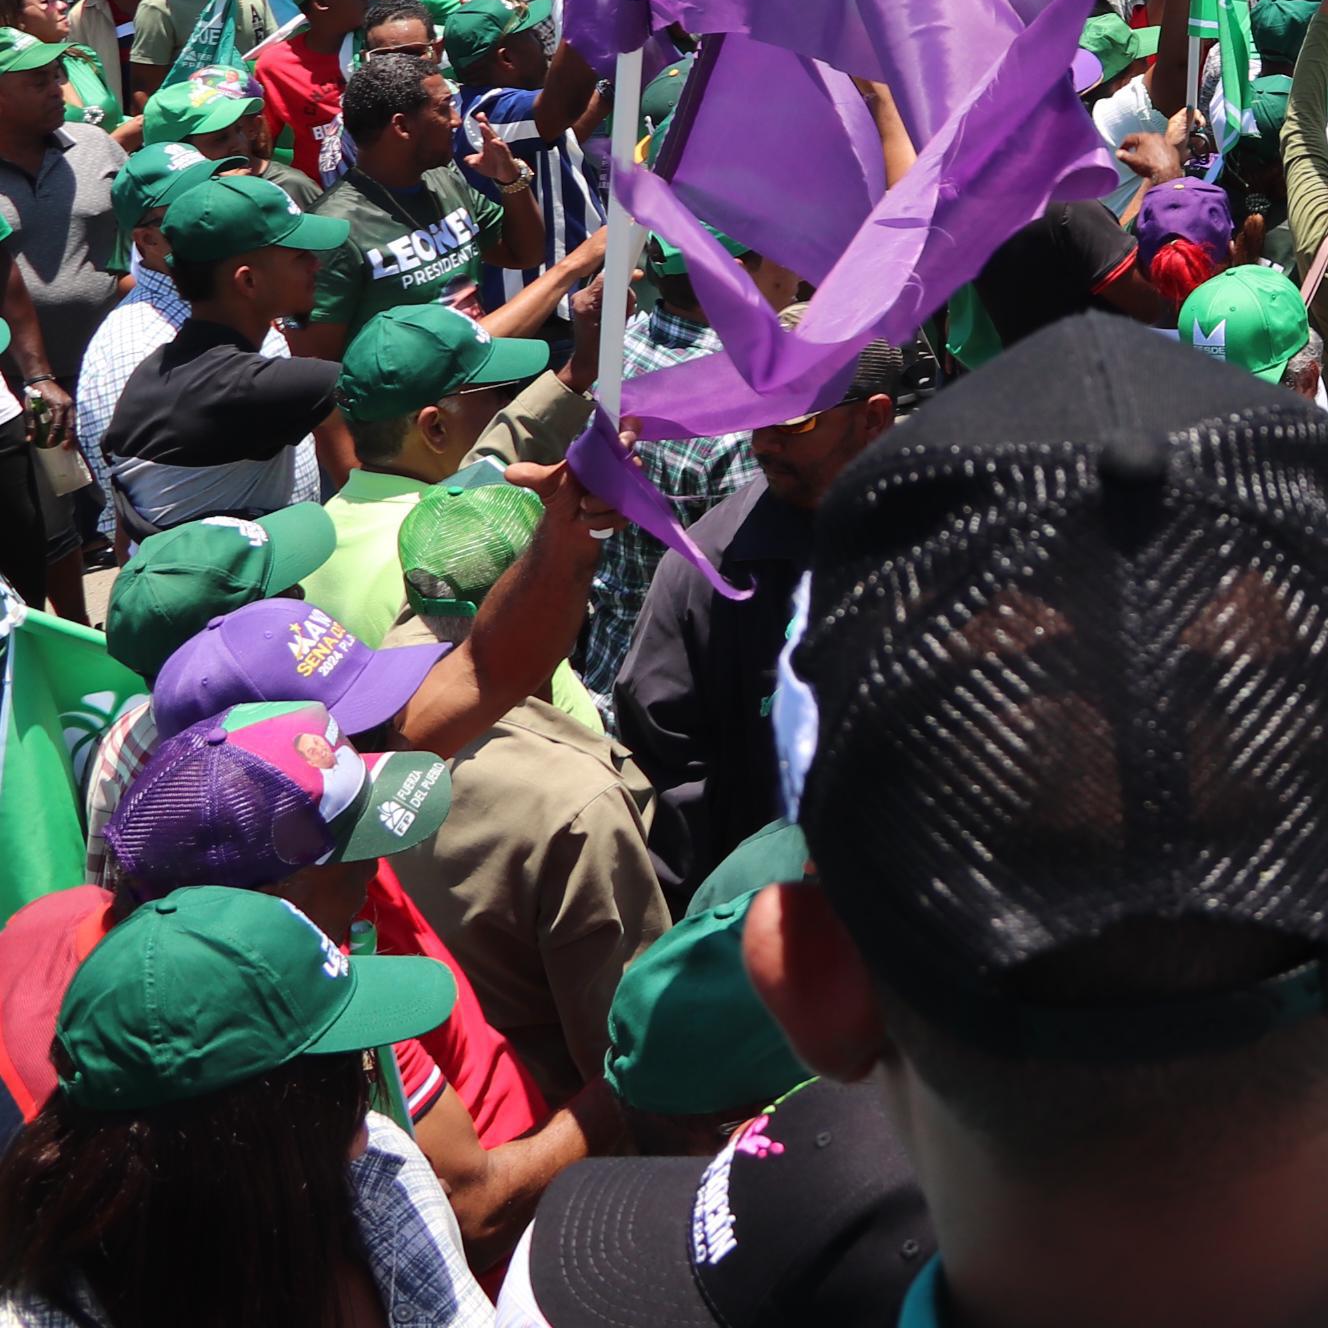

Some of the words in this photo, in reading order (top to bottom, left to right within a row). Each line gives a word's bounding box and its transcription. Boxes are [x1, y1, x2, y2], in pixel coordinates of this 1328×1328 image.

[366, 207, 480, 280] LEONEL
[402, 242, 480, 290] PRESIDENTE
[318, 652, 344, 677] 2024
[398, 769, 423, 801] FUERZA
[410, 785, 429, 809] DEL
[422, 762, 446, 790] PUEBLO
